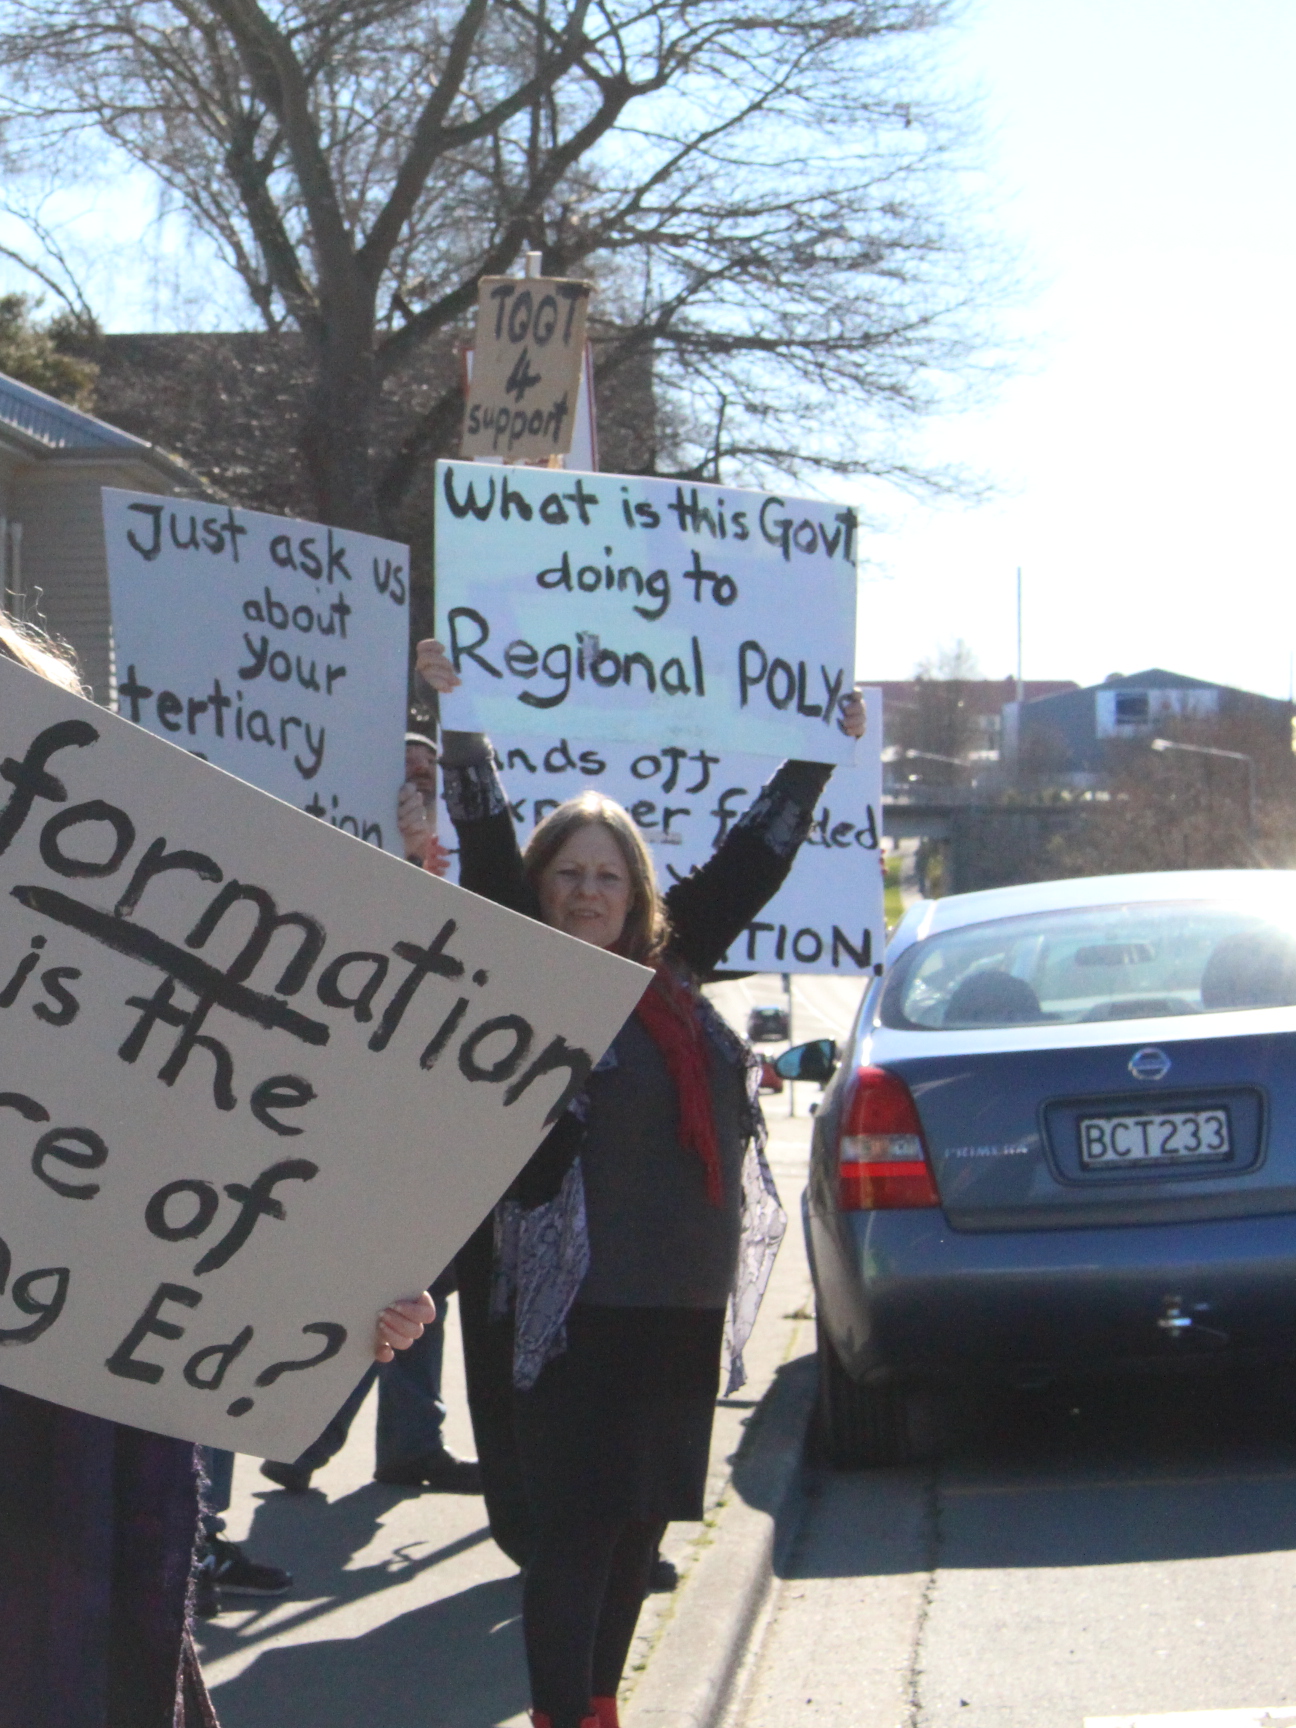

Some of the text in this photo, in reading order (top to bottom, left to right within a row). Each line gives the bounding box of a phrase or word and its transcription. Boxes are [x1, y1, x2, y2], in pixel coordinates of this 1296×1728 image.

[506, 346, 541, 403] 4
[468, 392, 568, 450] support
[444, 466, 598, 526] What
[621, 486, 661, 530] is
[668, 486, 750, 541] this
[127, 503, 247, 562] Just
[269, 528, 352, 584] ask
[243, 586, 352, 639] about
[536, 547, 738, 620] doing to
[239, 633, 346, 695] your
[448, 606, 705, 708] Regional
[119, 665, 325, 779] tertiary
[495, 738, 606, 776] nds
[117, 980, 318, 1136] the
[1085, 1115, 1224, 1159] BCT233
[144, 1157, 319, 1276] of
[104, 1282, 346, 1417] Ed?
